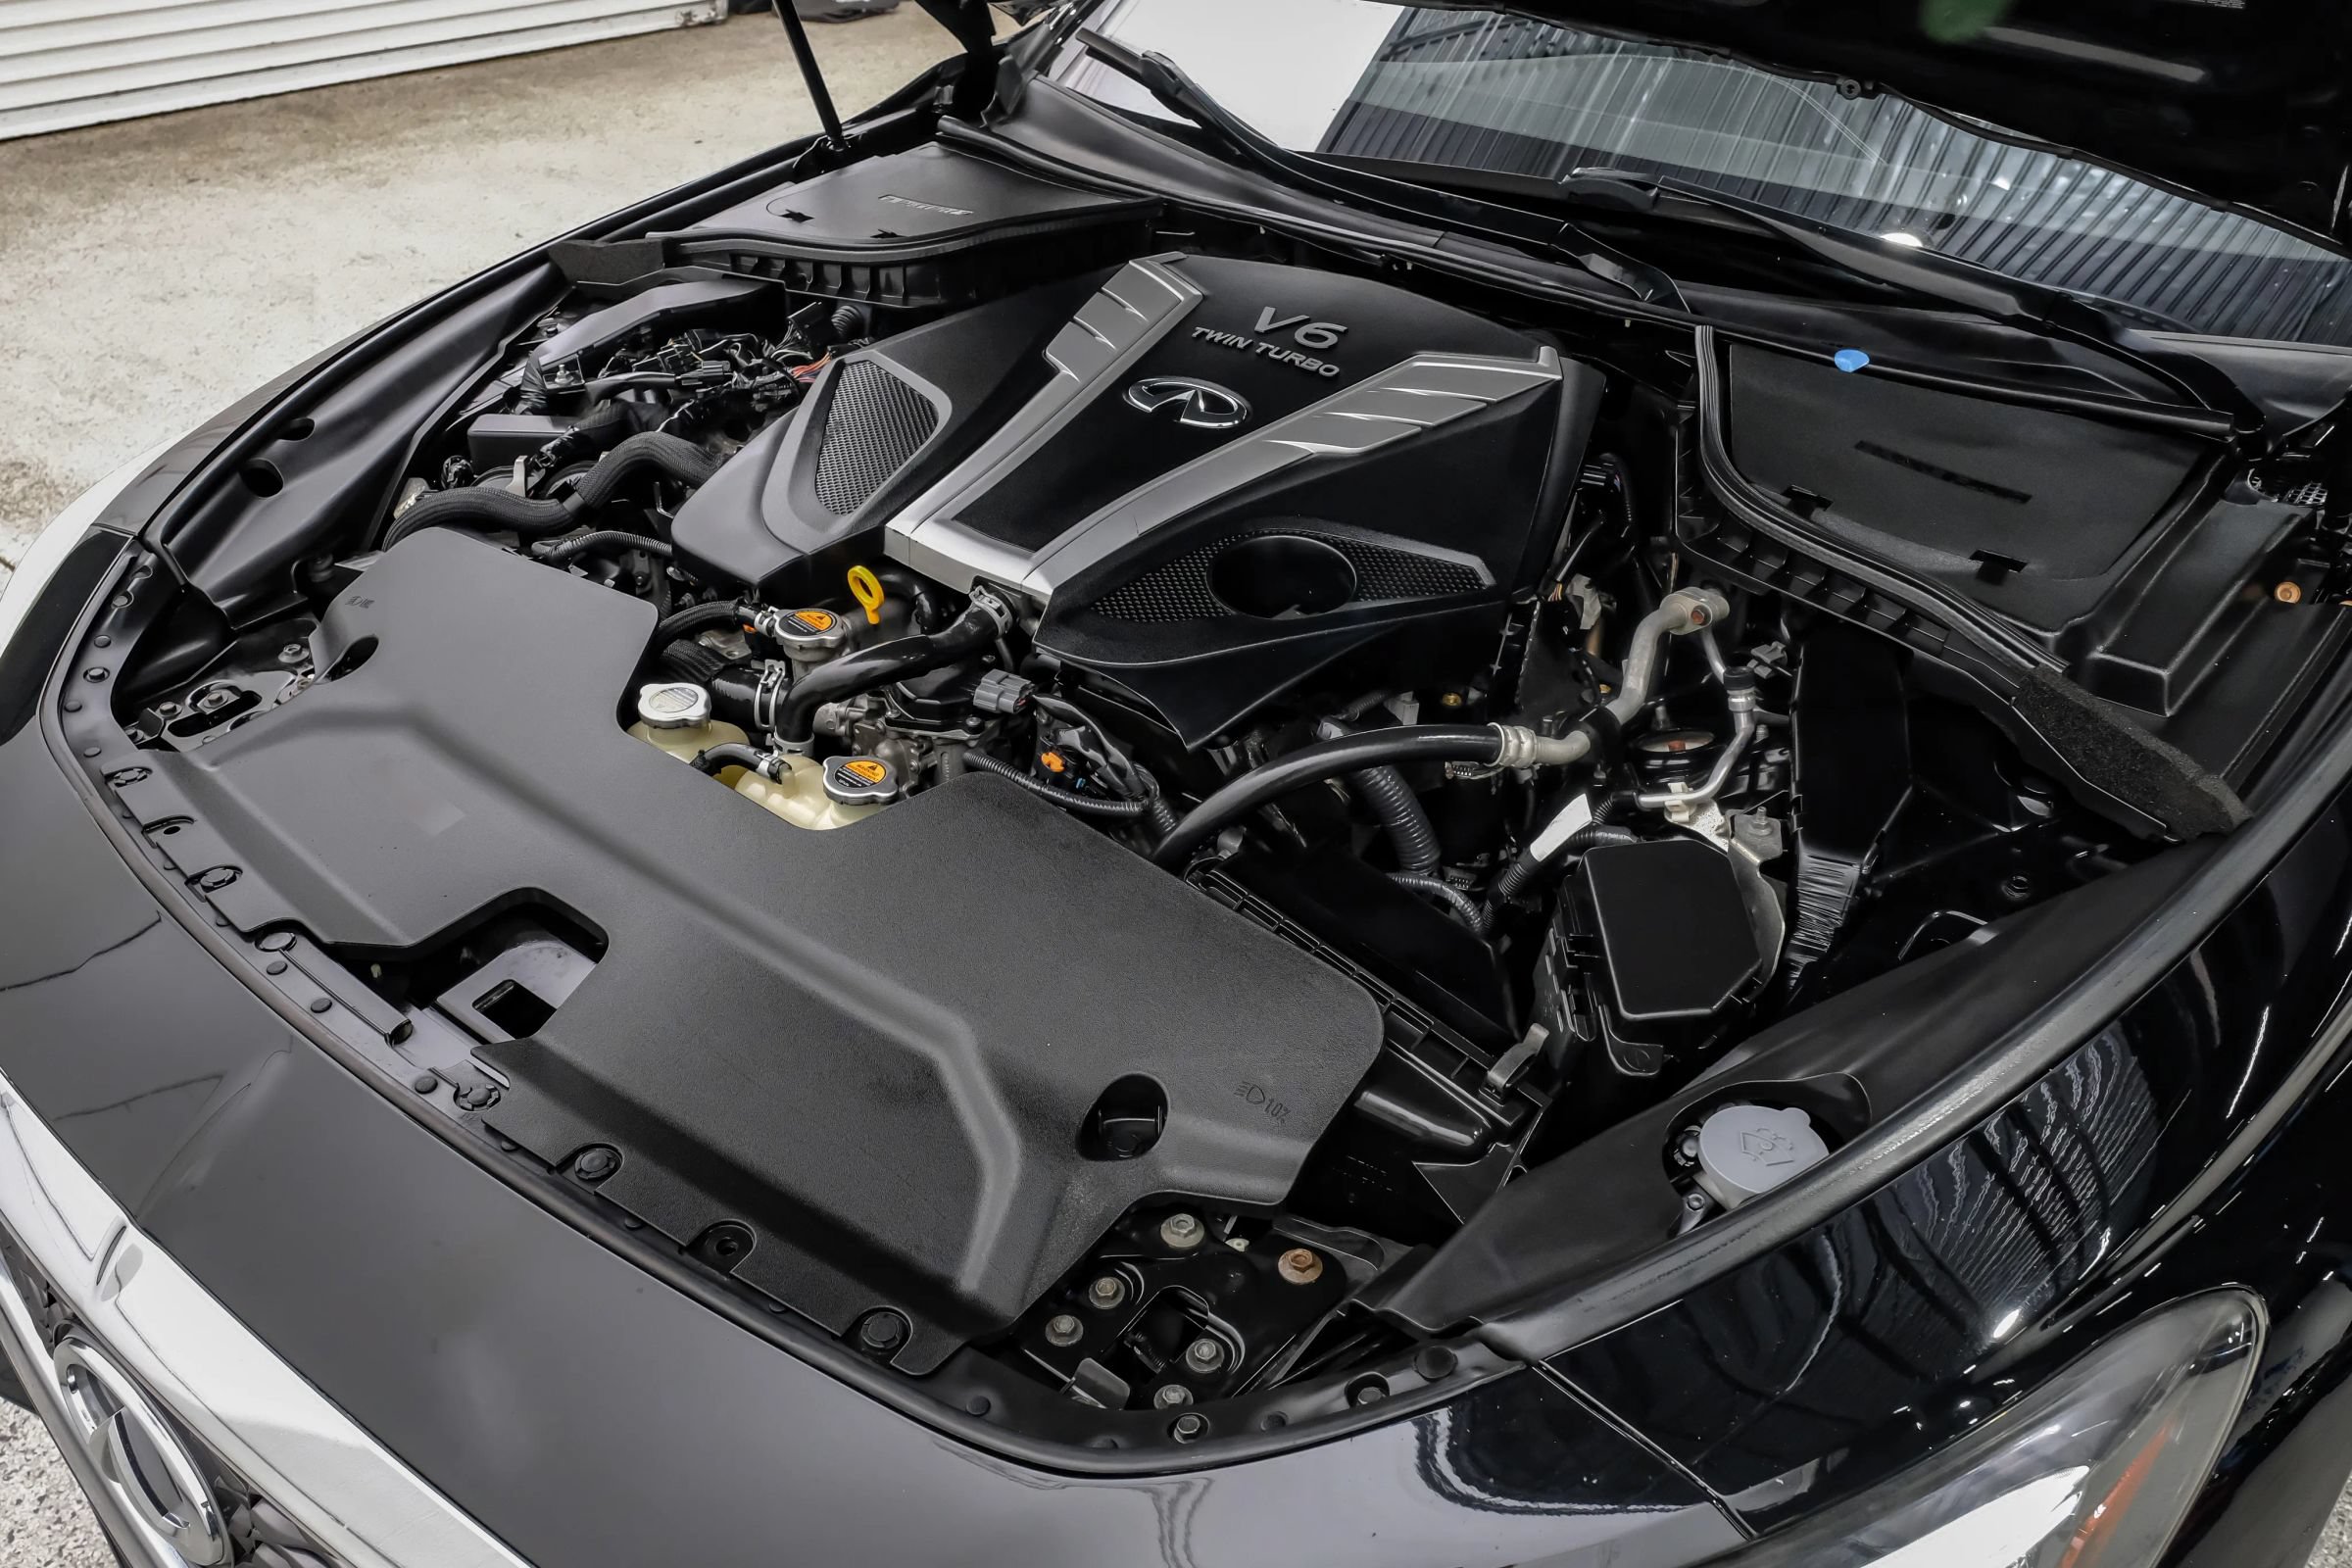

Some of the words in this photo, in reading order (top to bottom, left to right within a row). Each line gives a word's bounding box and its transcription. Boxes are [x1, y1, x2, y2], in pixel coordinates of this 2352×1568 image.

[1253, 307, 1348, 349] V6
[1191, 326, 1253, 350] TWIN
[1255, 342, 1340, 377] TURBO
